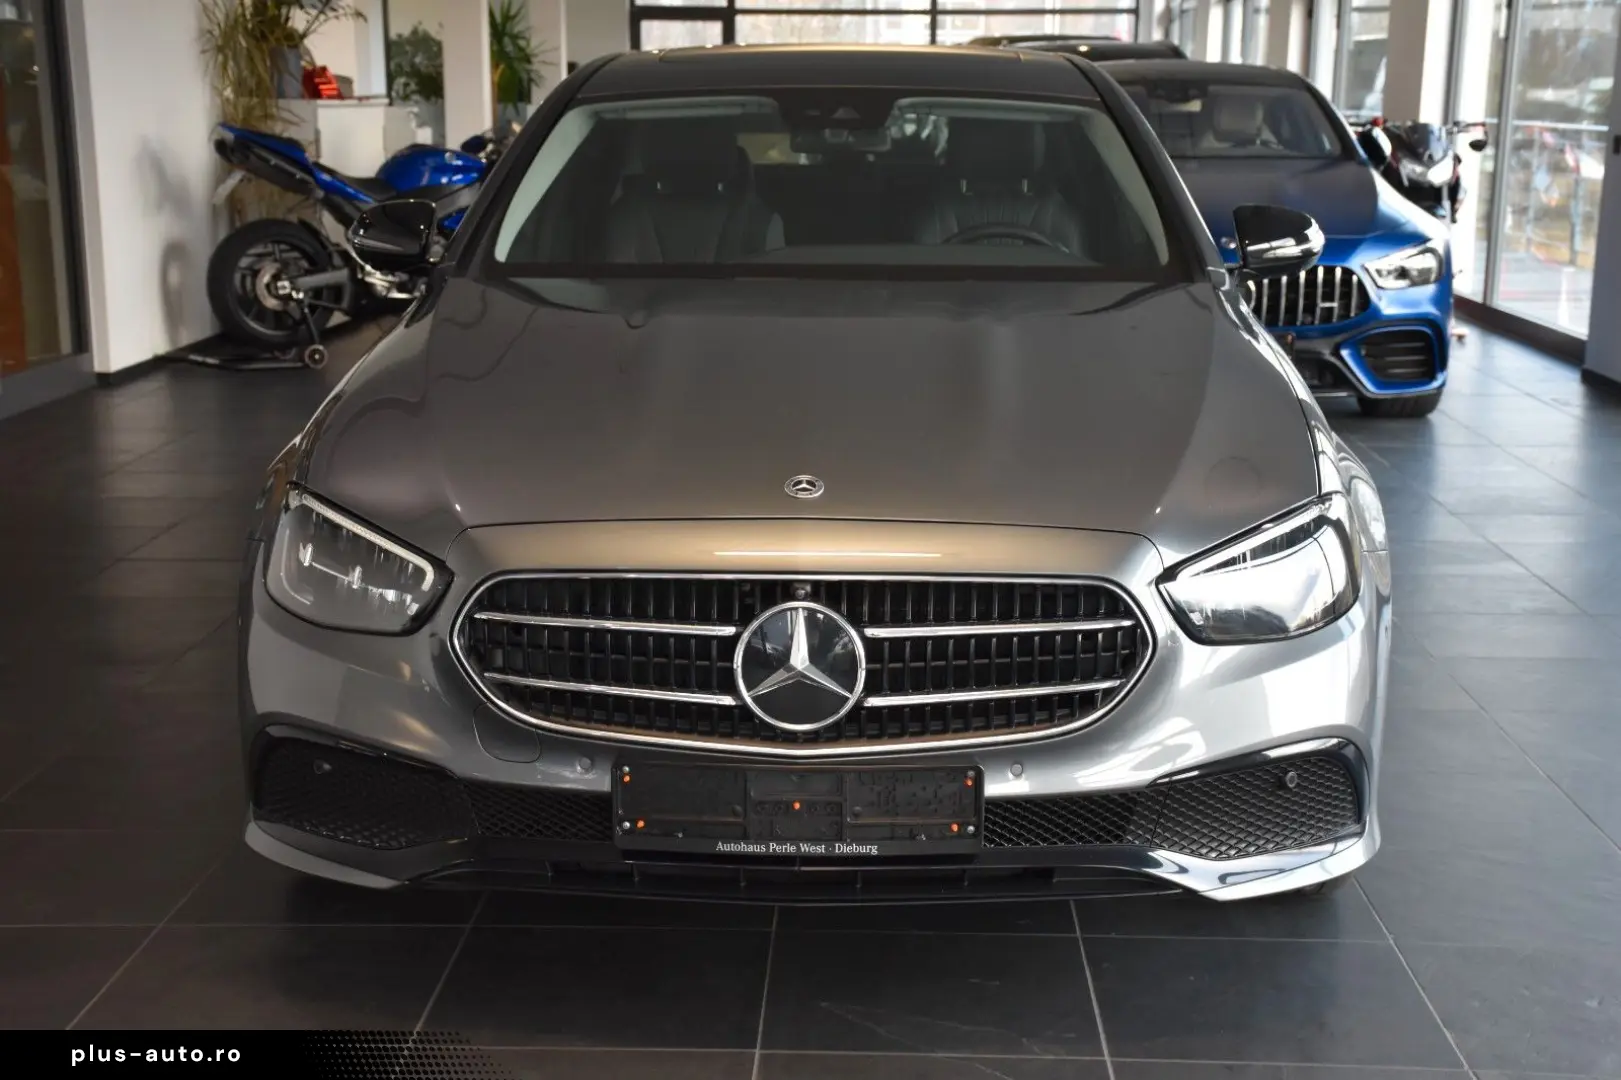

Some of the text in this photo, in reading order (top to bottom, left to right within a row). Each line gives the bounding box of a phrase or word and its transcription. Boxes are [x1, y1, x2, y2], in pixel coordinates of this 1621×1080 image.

[715, 841, 878, 856] Autohaus Perle West Dieburg
